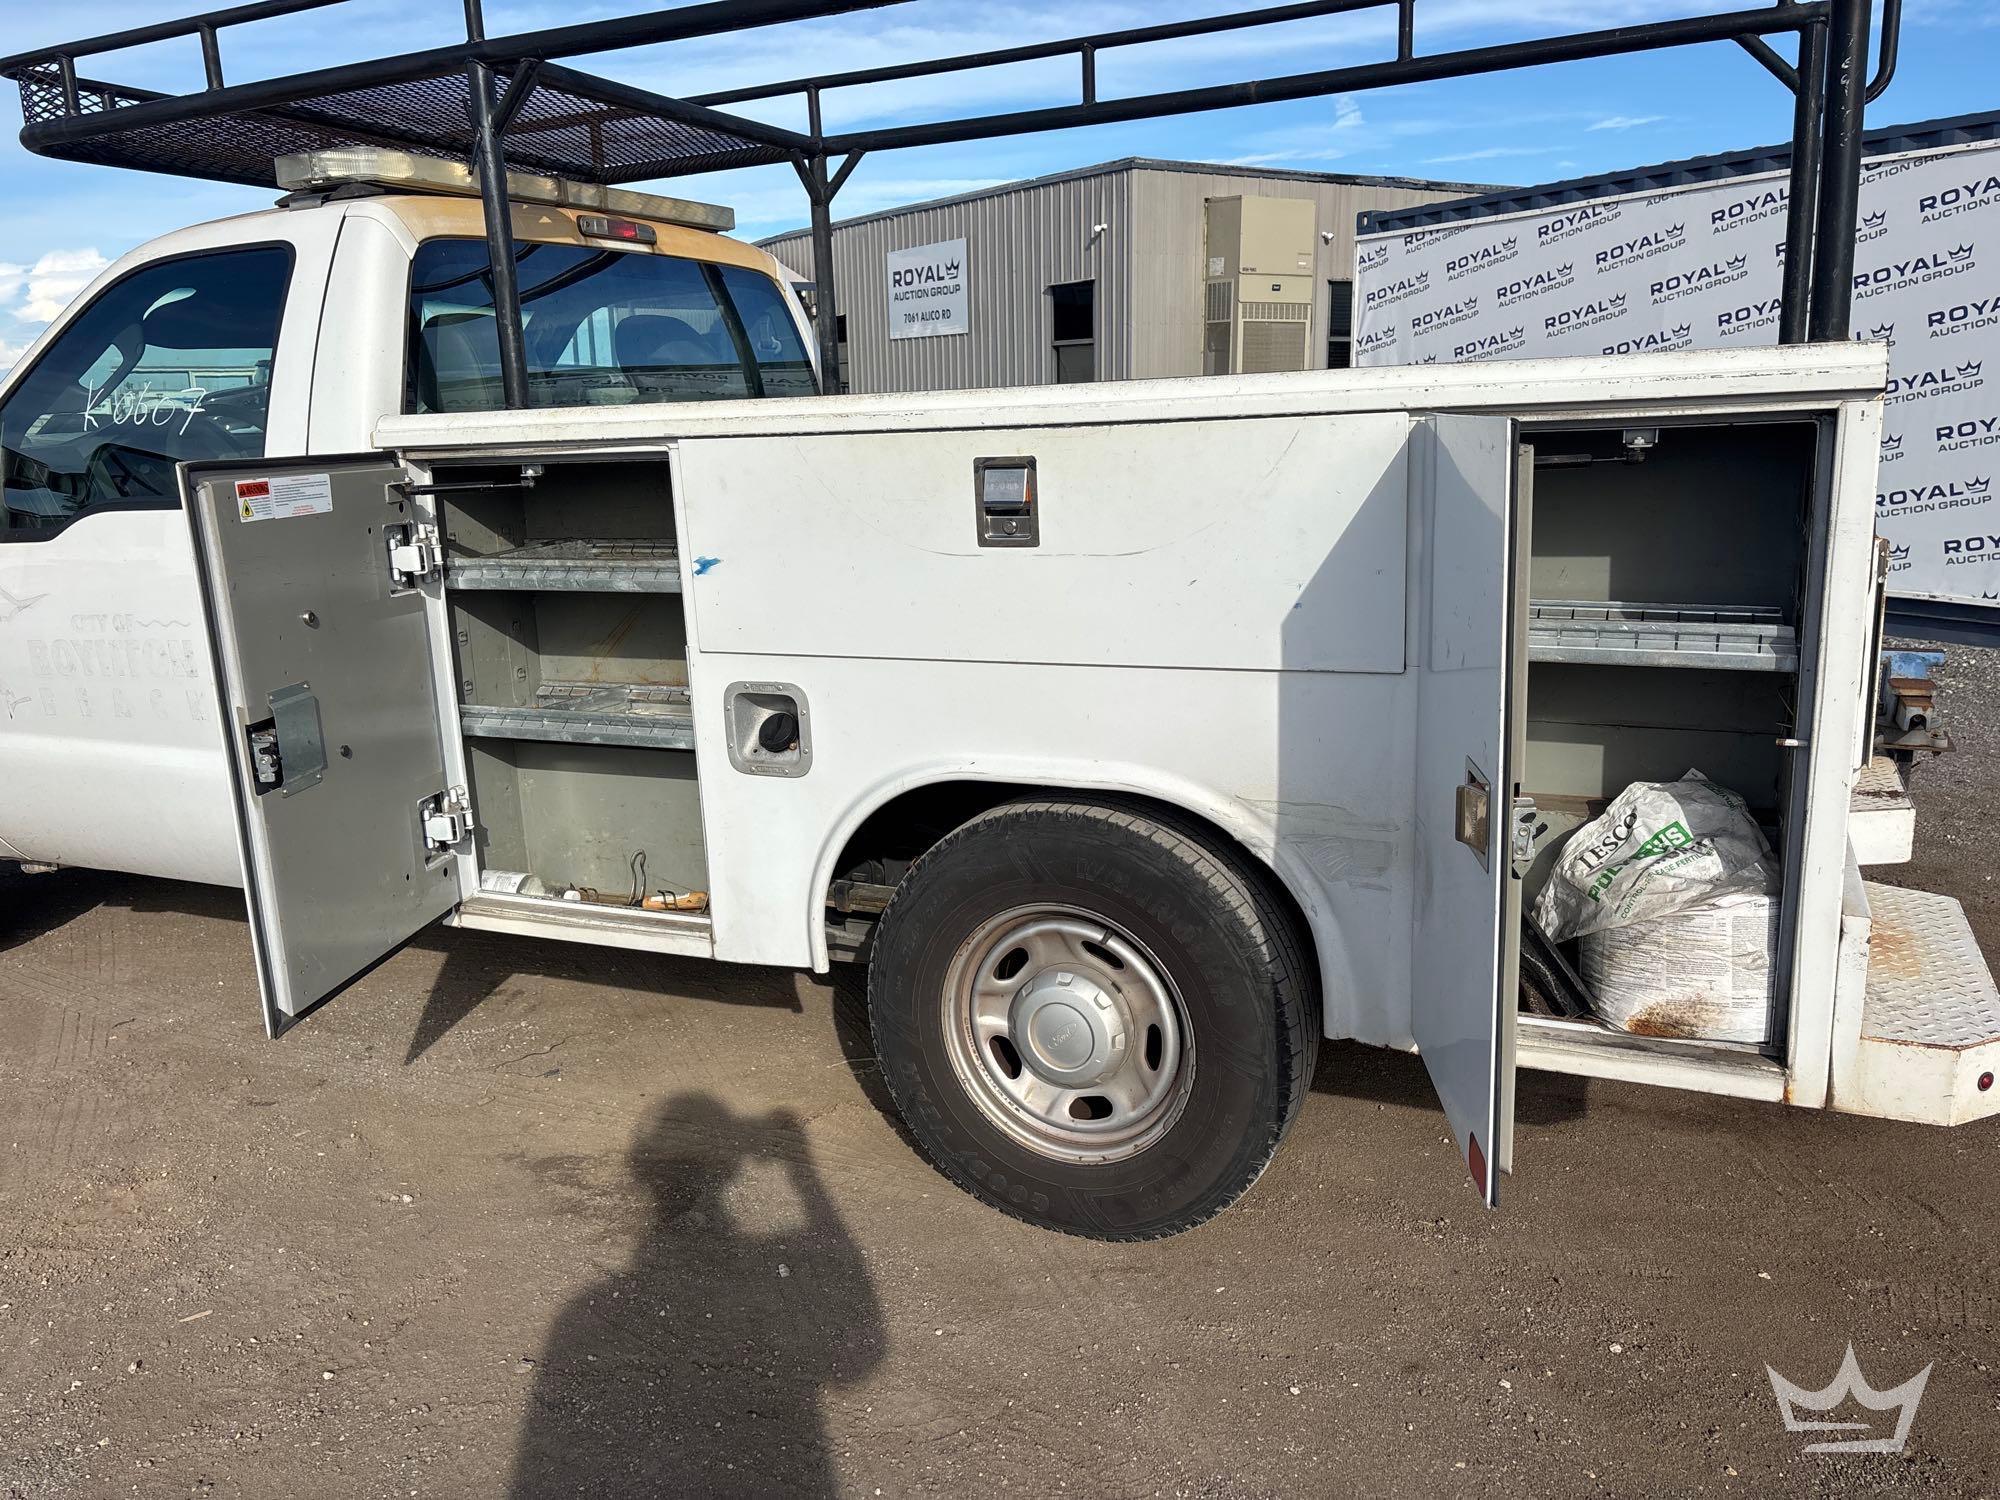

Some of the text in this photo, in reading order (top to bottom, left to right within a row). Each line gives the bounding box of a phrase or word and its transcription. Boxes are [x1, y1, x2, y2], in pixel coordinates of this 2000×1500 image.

[1858, 161, 1911, 186] UCTION
[1919, 176, 2000, 213] ROYA
[1538, 205, 1603, 239] ROYAL
[1712, 211, 1767, 236] AUCTION
[1921, 197, 1990, 224] AUCTION
[1405, 225, 1472, 255] AUCTION GROUP
[1539, 212, 1622, 248] AUCTION GROUP
[1855, 228, 1888, 244] OUP
[1446, 243, 1501, 274] ROYAL
[1595, 231, 1665, 265] ROYAL
[1597, 238, 1686, 275] AUCTION GROUP
[892, 264, 945, 288] ROYAL
[1362, 257, 1389, 273] GROUP
[1448, 250, 1519, 282] AUCTION GROUP
[1853, 252, 1947, 290] ROYAL
[893, 284, 960, 302] AUCTION GROUP
[1366, 278, 1416, 303] ROYAL
[1496, 271, 1557, 300] ROYAL
[1498, 276, 1575, 309] AUCTION GROUP
[1649, 263, 1726, 296] ROYAL
[1651, 271, 1748, 306] AUCTION GROUP
[1855, 261, 1976, 301] AUCTION GROUP
[1367, 284, 1430, 312] AUCTION GROUP
[903, 312, 919, 324] 7061
[941, 309, 951, 320] RD
[1411, 303, 1464, 329] ROYAL
[1413, 310, 1479, 338] AUCTION GROUP
[1544, 301, 1607, 330] ROYAL
[1546, 307, 1628, 339] AUCTION GROUP
[1717, 298, 1781, 327] ROYA
[1927, 297, 2000, 328] ROYA
[1356, 332, 1383, 348] YAL
[1719, 315, 1775, 338] AUCTION
[1929, 316, 1998, 339] AUCTION
[1370, 338, 1397, 352] GROUP
[1453, 333, 1510, 358] ROYAL
[1494, 340, 1526, 355] GROUP
[1883, 379, 1984, 406] CTION GROUP
[1885, 369, 1956, 395] OYAL
[1936, 417, 2000, 441] ROY
[1879, 452, 1904, 463] OUP
[1938, 495, 1992, 510] GROUP
[1944, 535, 2000, 555] ROY
[1946, 553, 2000, 566] AUCTIO
